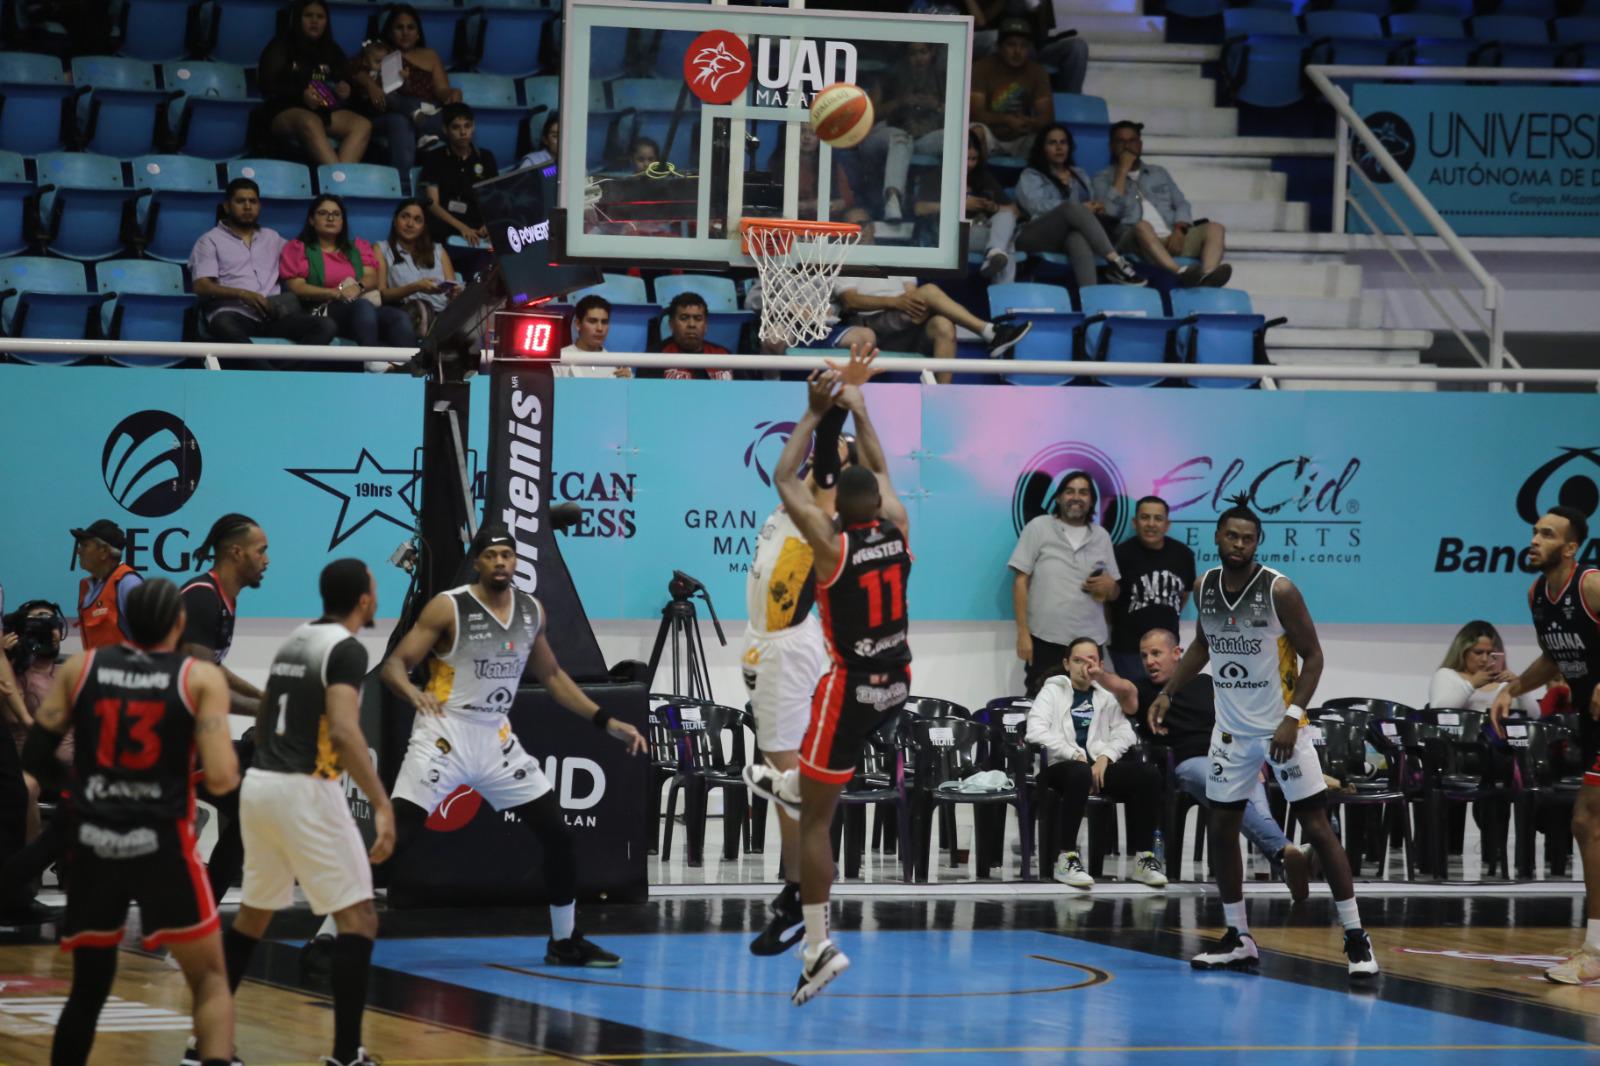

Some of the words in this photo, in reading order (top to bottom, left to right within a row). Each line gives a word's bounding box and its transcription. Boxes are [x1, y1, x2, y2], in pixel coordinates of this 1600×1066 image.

[756, 37, 858, 91] UAD
[756, 89, 817, 108] MAZAT
[1428, 111, 1600, 160] UNIVERSI
[1428, 162, 1551, 187] AUTÓNOMA
[1560, 168, 1586, 186] DE
[524, 323, 551, 352] 10
[355, 482, 392, 498] 19hrs
[502, 390, 542, 594] ortenis
[1153, 456, 1244, 513] El
[1248, 455, 1361, 515] Cid
[685, 509, 756, 529] GRAN
[713, 536, 751, 555] MA
[852, 540, 903, 565] WEBSTER
[1254, 550, 1296, 562] zumel
[1309, 554, 1361, 563] cancun
[729, 563, 748, 573] MA
[859, 563, 903, 628] 11
[97, 667, 170, 690] WILLIAMS
[1234, 680, 1269, 689] Azteca
[274, 693, 288, 736] 1
[681, 721, 706, 730] TECATE
[94, 699, 165, 770] 13
[1004, 725, 1018, 734] TEC
[931, 738, 955, 746] TECATE
